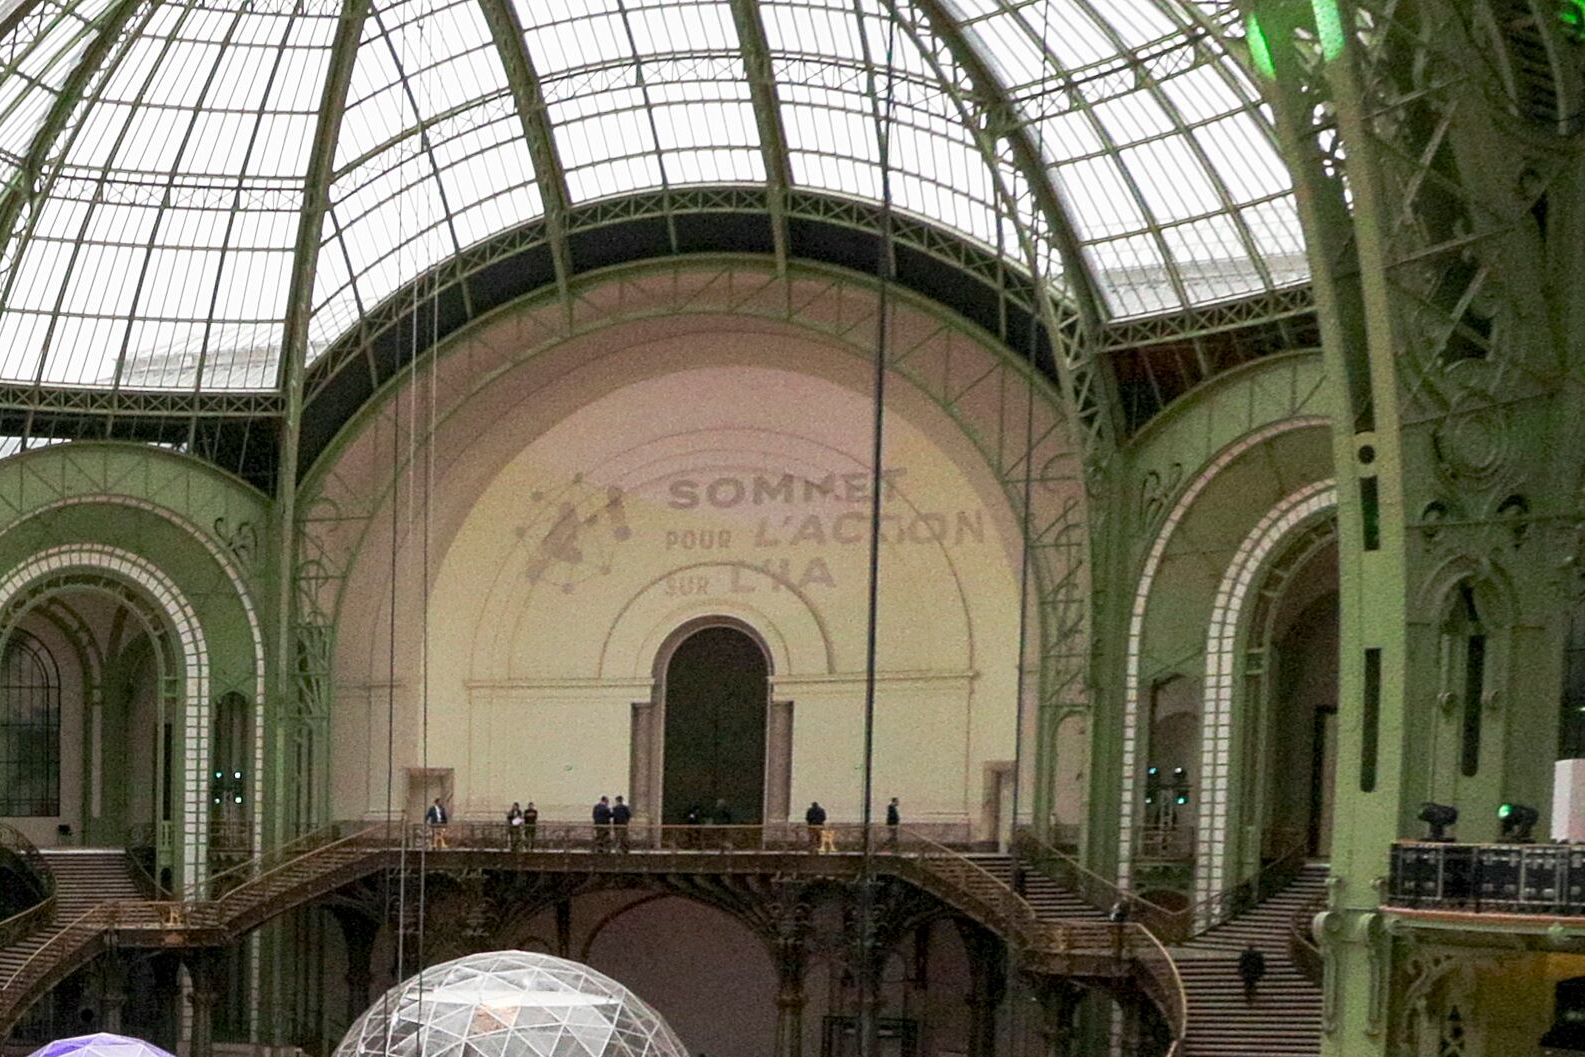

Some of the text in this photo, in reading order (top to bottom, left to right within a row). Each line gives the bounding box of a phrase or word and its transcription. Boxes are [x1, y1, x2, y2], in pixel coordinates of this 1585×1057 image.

[667, 467, 907, 510] SOMMET
[665, 511, 985, 550] POUR L'ACTION
[664, 575, 710, 597] SUR
